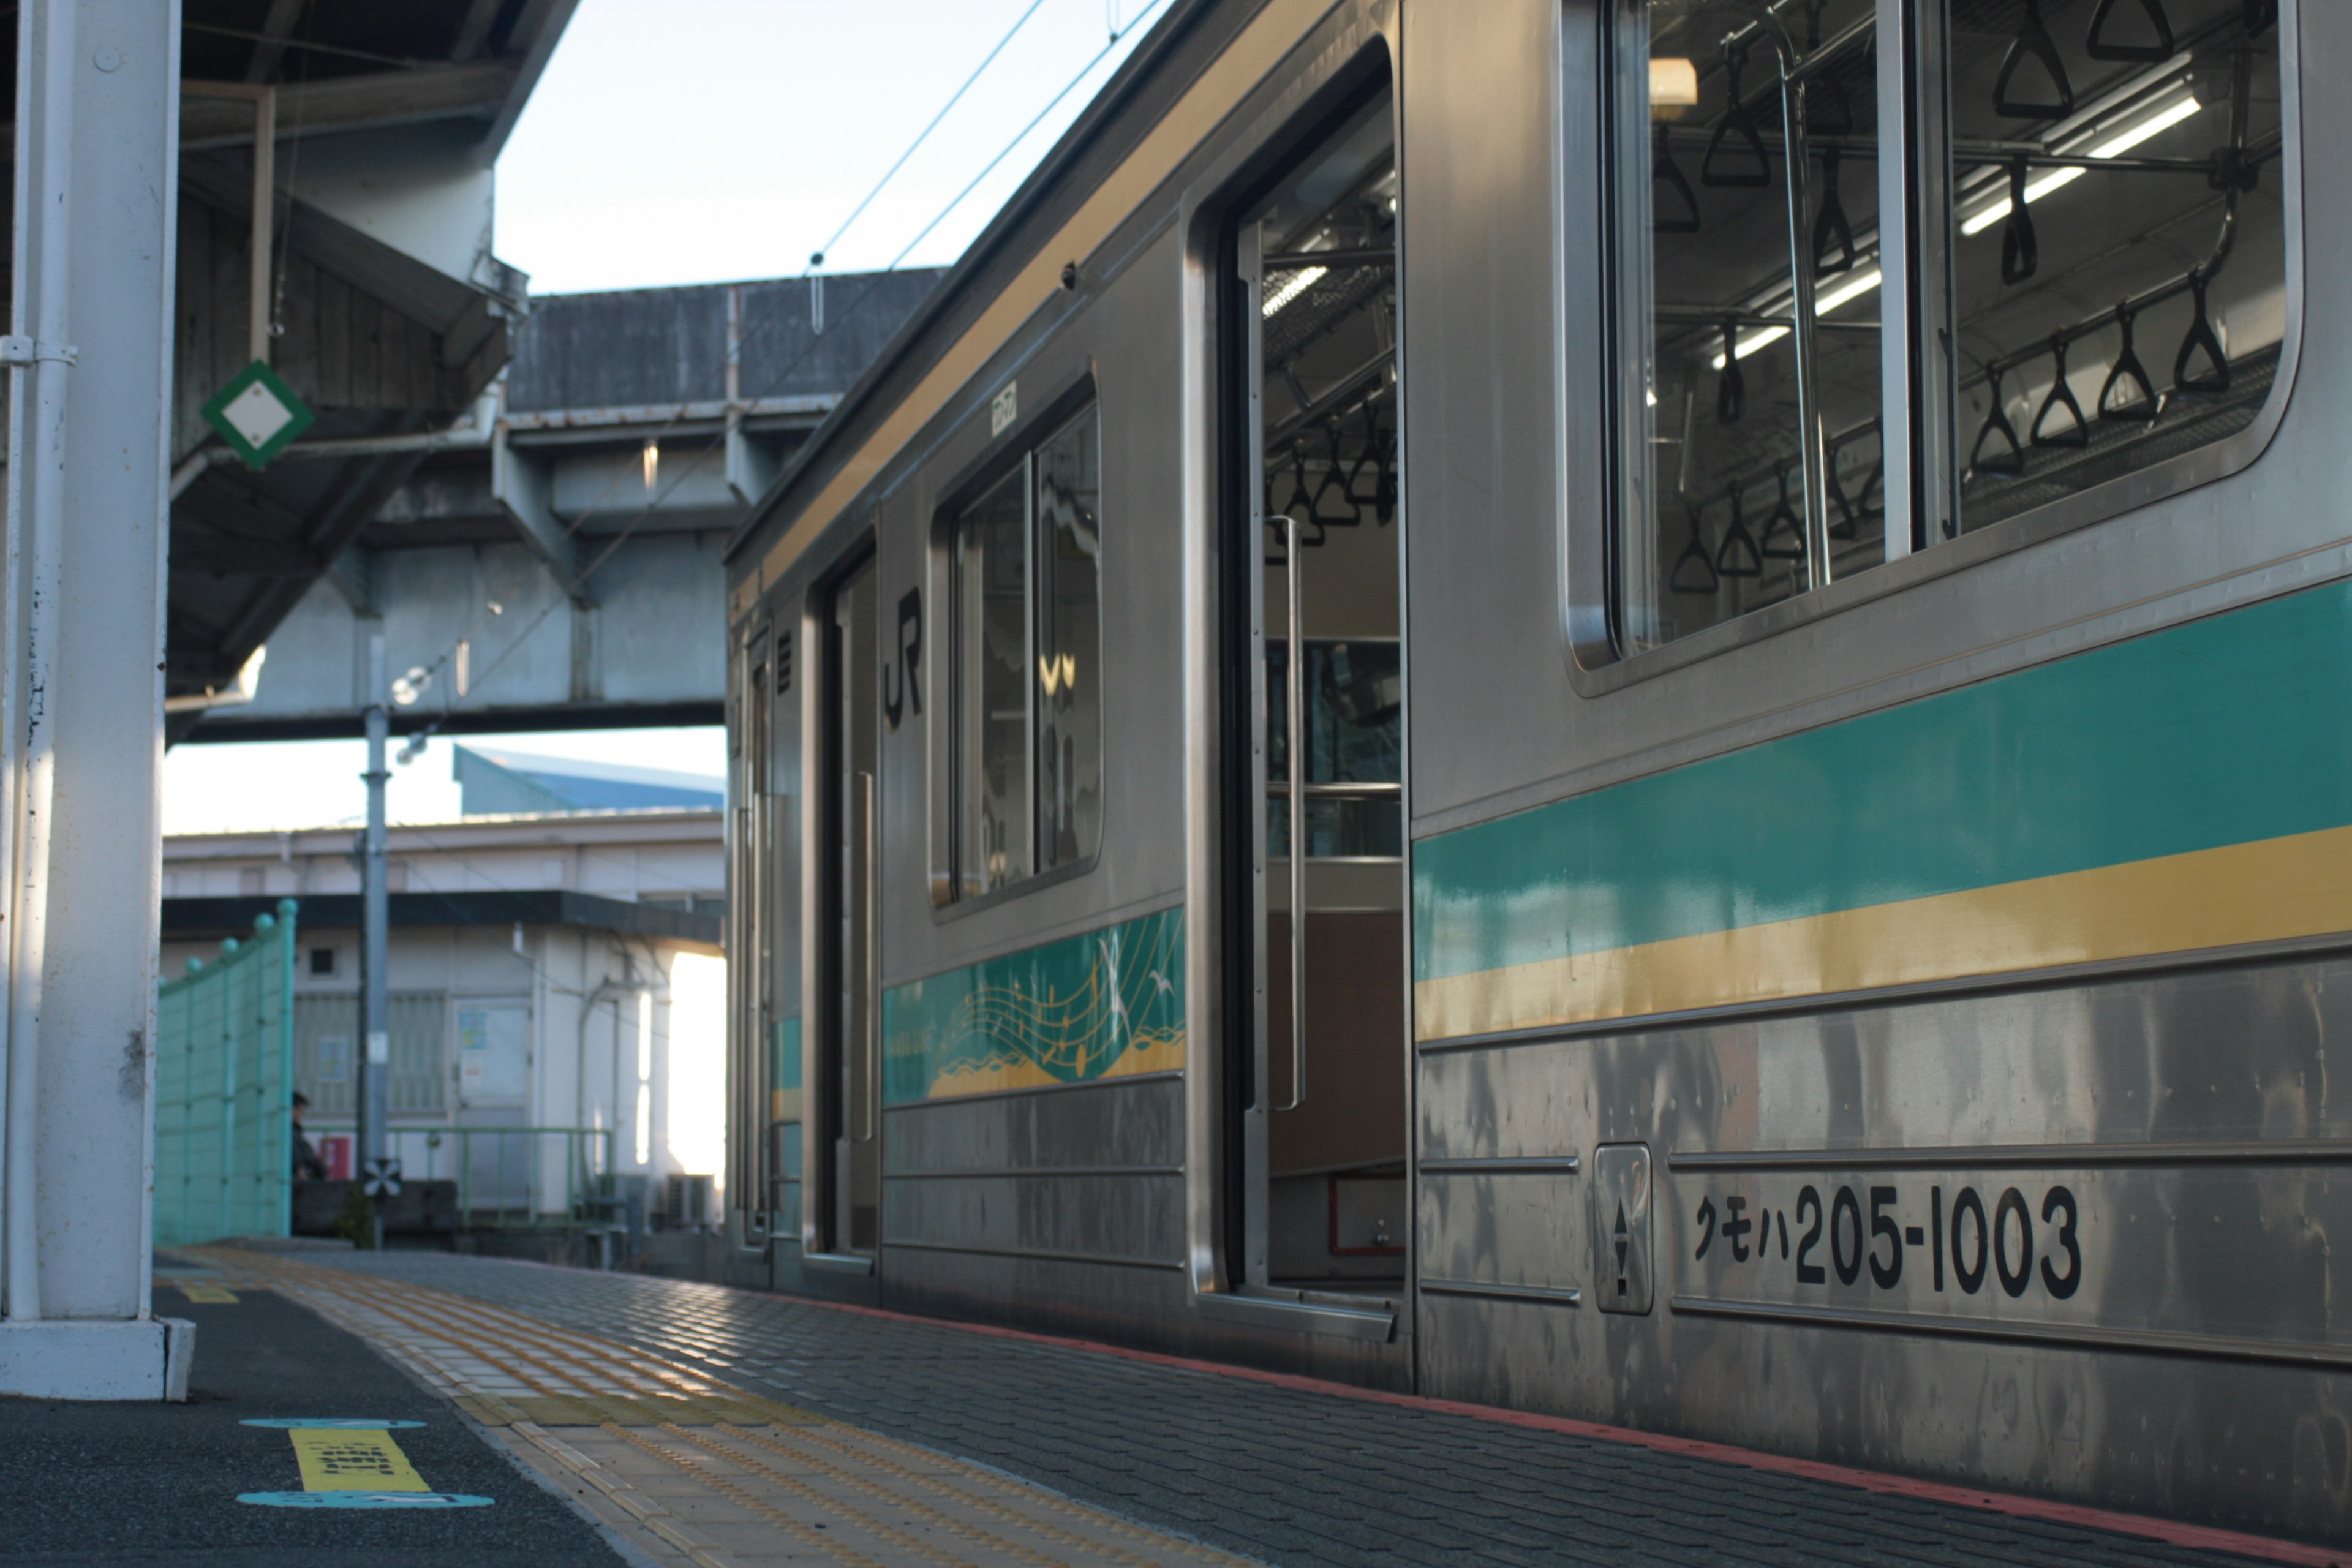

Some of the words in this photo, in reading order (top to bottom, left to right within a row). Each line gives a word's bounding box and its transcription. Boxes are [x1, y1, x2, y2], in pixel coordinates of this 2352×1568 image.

[884, 586, 922, 733] JR
[1695, 1185, 2082, 1300] クモハ205-1003
